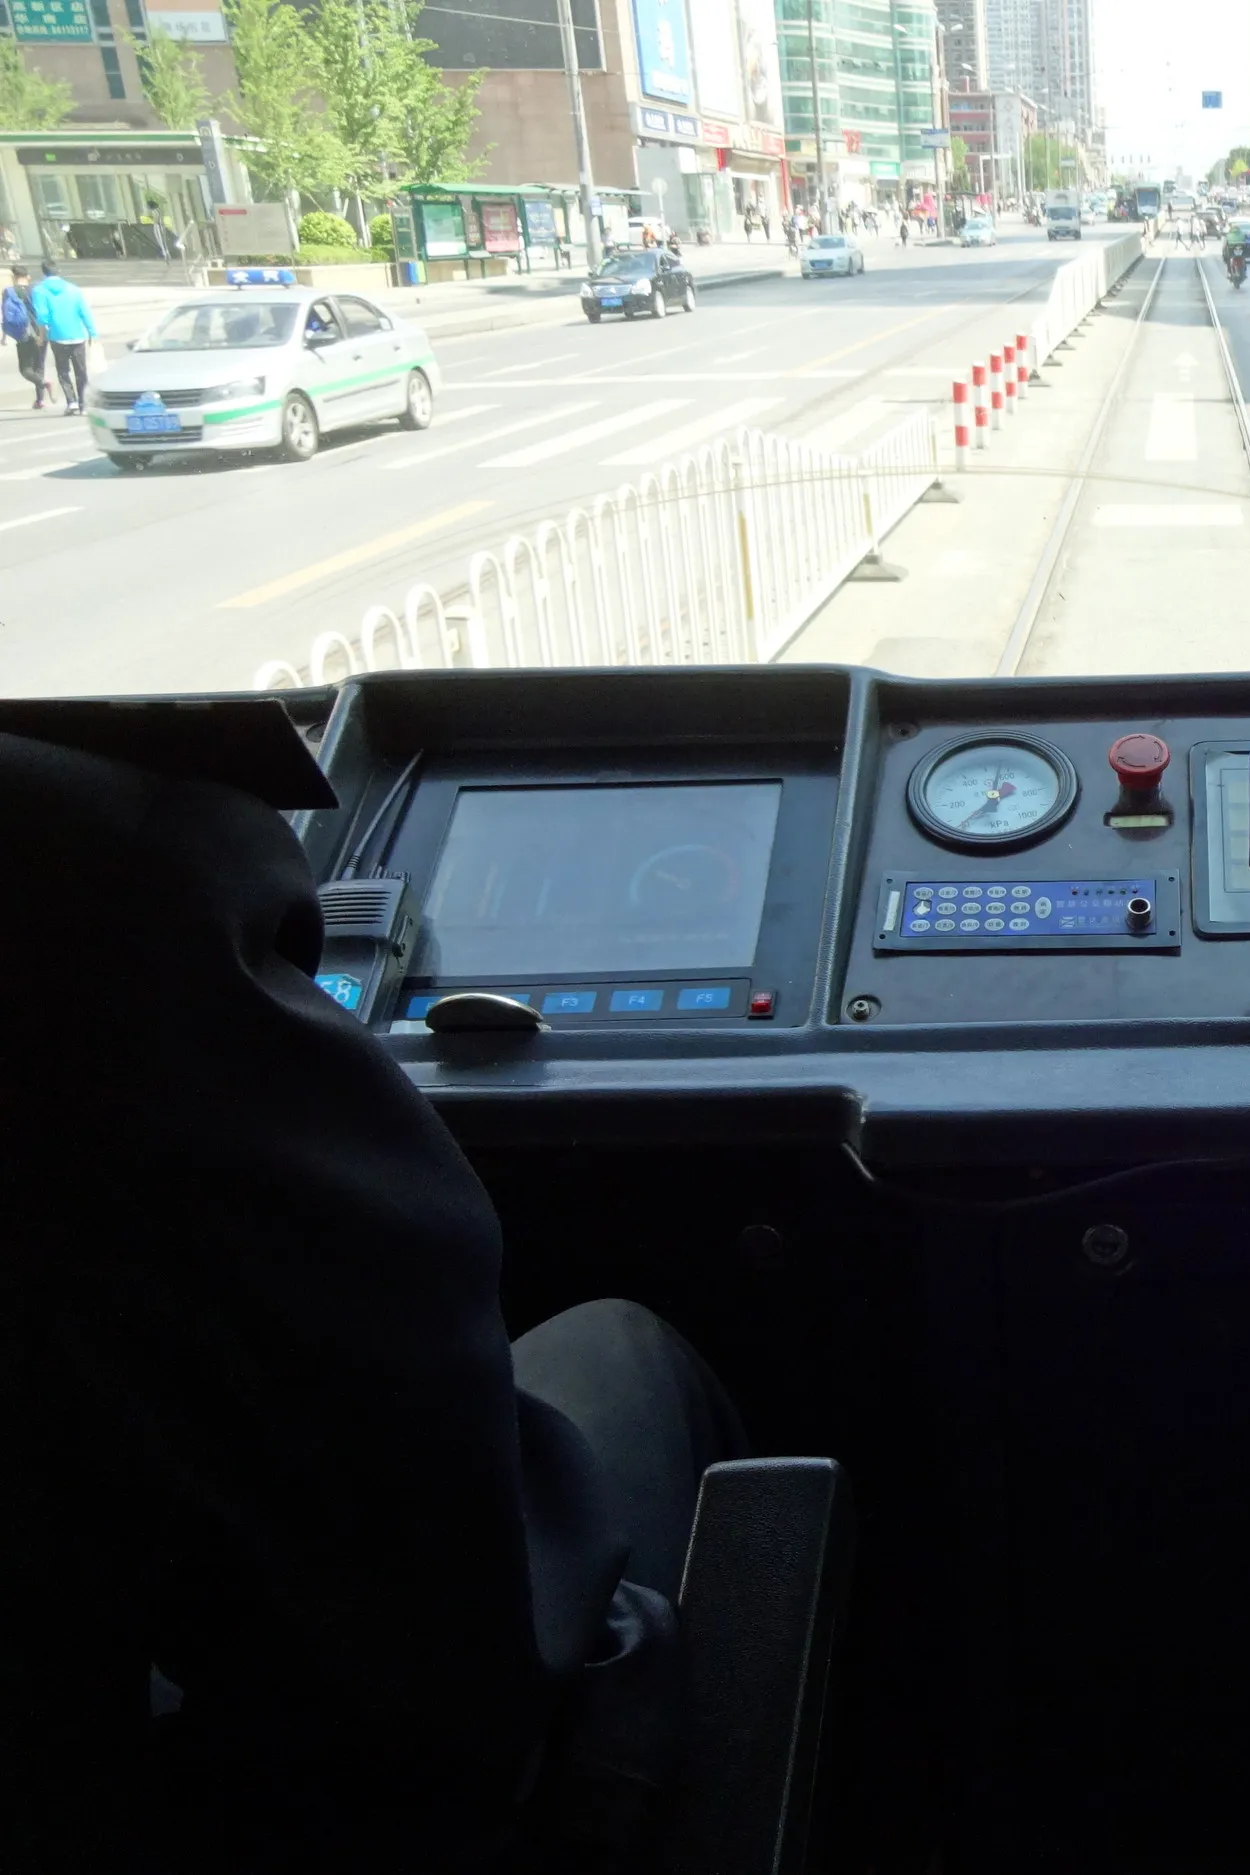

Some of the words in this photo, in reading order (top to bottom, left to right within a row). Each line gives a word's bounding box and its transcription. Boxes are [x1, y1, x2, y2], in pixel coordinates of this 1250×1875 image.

[999, 772, 1015, 781] 600
[962, 779, 978, 787] 400
[1022, 789, 1038, 797] 800
[949, 801, 965, 809] 200
[1018, 811, 1038, 820] 1000
[990, 820, 1009, 829] kPa
[560, 997, 580, 1008] F3
[628, 995, 647, 1006] F4
[695, 993, 714, 1004] F5
